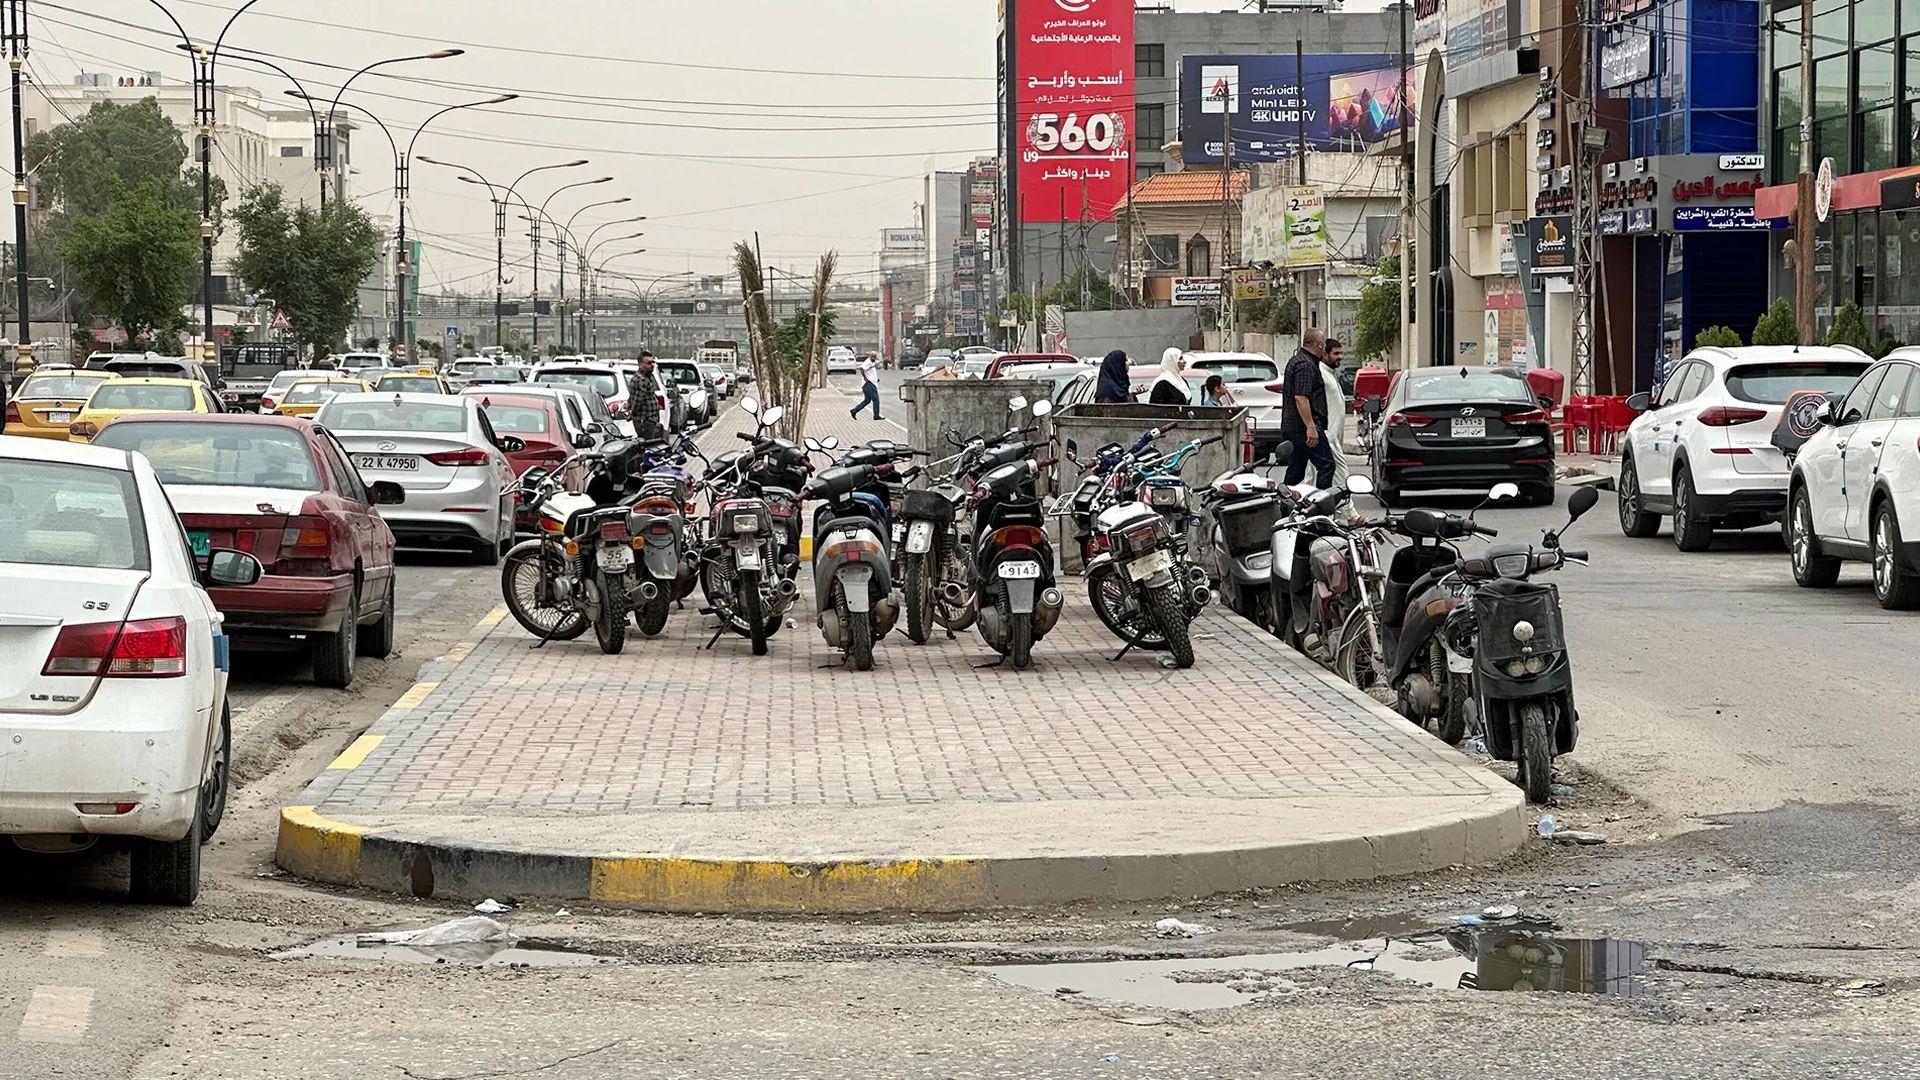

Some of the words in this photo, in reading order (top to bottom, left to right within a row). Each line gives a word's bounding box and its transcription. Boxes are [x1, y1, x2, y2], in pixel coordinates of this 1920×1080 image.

[1027, 69, 1076, 88] وأربح
[1077, 69, 1123, 88] أسحب
[1251, 99, 1277, 108] Mini
[1252, 110, 1271, 121] 4K
[1035, 112, 1114, 151] 560
[1023, 147, 1129, 163] مليون
[1725, 156, 1761, 169] الدكتور
[1079, 167, 1111, 180] دينار
[1672, 175, 1715, 202] الدين
[1715, 173, 1765, 201] شمس
[1676, 207, 1710, 220] والشرايين
[1711, 207, 1729, 219] القلب
[1730, 207, 1755, 219] قسطرة
[1707, 219, 1734, 229] قلبية
[1740, 219, 1771, 229] باطنية
[362, 457, 374, 468] 22
[377, 457, 384, 468] K
[386, 458, 416, 469] 47950
[83, 600, 110, 611] G3
